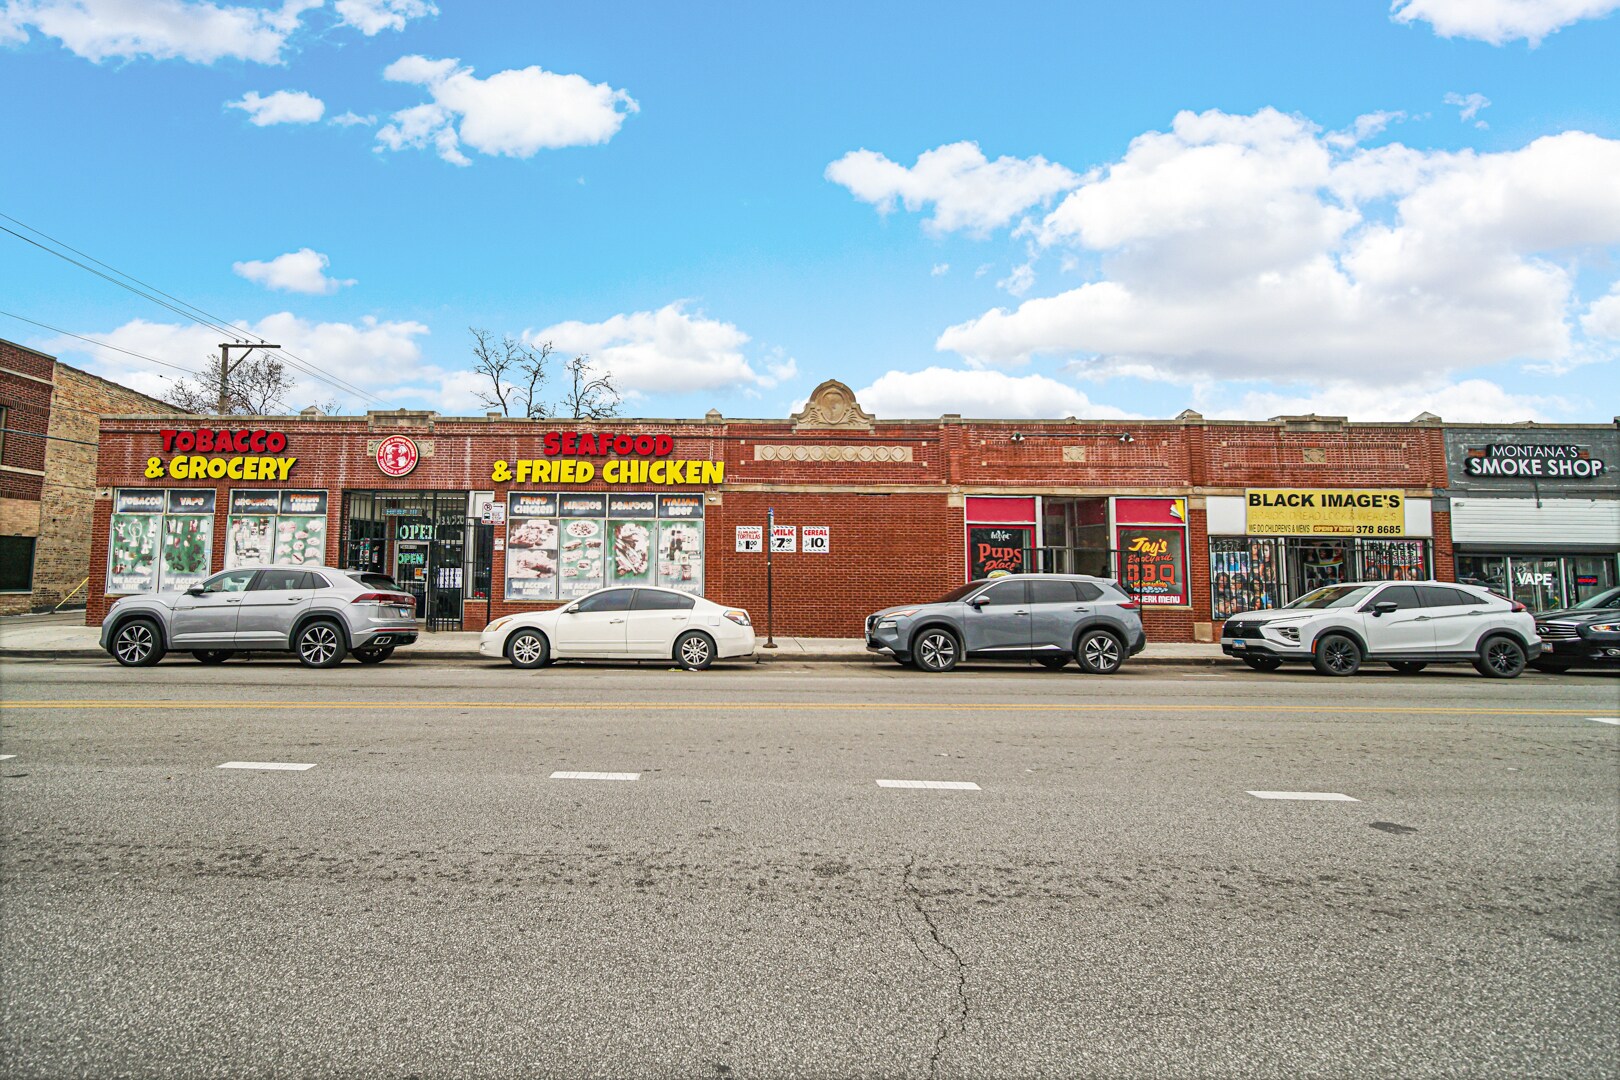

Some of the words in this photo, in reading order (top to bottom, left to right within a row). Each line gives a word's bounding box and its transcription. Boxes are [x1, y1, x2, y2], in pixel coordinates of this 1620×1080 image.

[160, 429, 286, 453] TOBACCO
[543, 432, 674, 456] SEAFOOD
[1492, 446, 1578, 458] MONTANA'S
[144, 456, 165, 479] &
[169, 455, 297, 481] GROCERY
[491, 460, 513, 483] &
[516, 460, 595, 483] FRIED
[602, 460, 725, 485] CHICKEN
[1471, 458, 1543, 475] SMOKE
[1547, 459, 1604, 476] SHOP
[1249, 494, 1314, 507] BLACK
[1321, 494, 1401, 508] IMAGE'S
[1356, 525, 1374, 534] 378
[1378, 525, 1401, 534] 8685
[978, 543, 1022, 564] Pups
[1128, 537, 1168, 557] Jay's
[984, 560, 1016, 572] Place
[1516, 572, 1552, 586] VAPE
[1158, 595, 1180, 604] MENU
